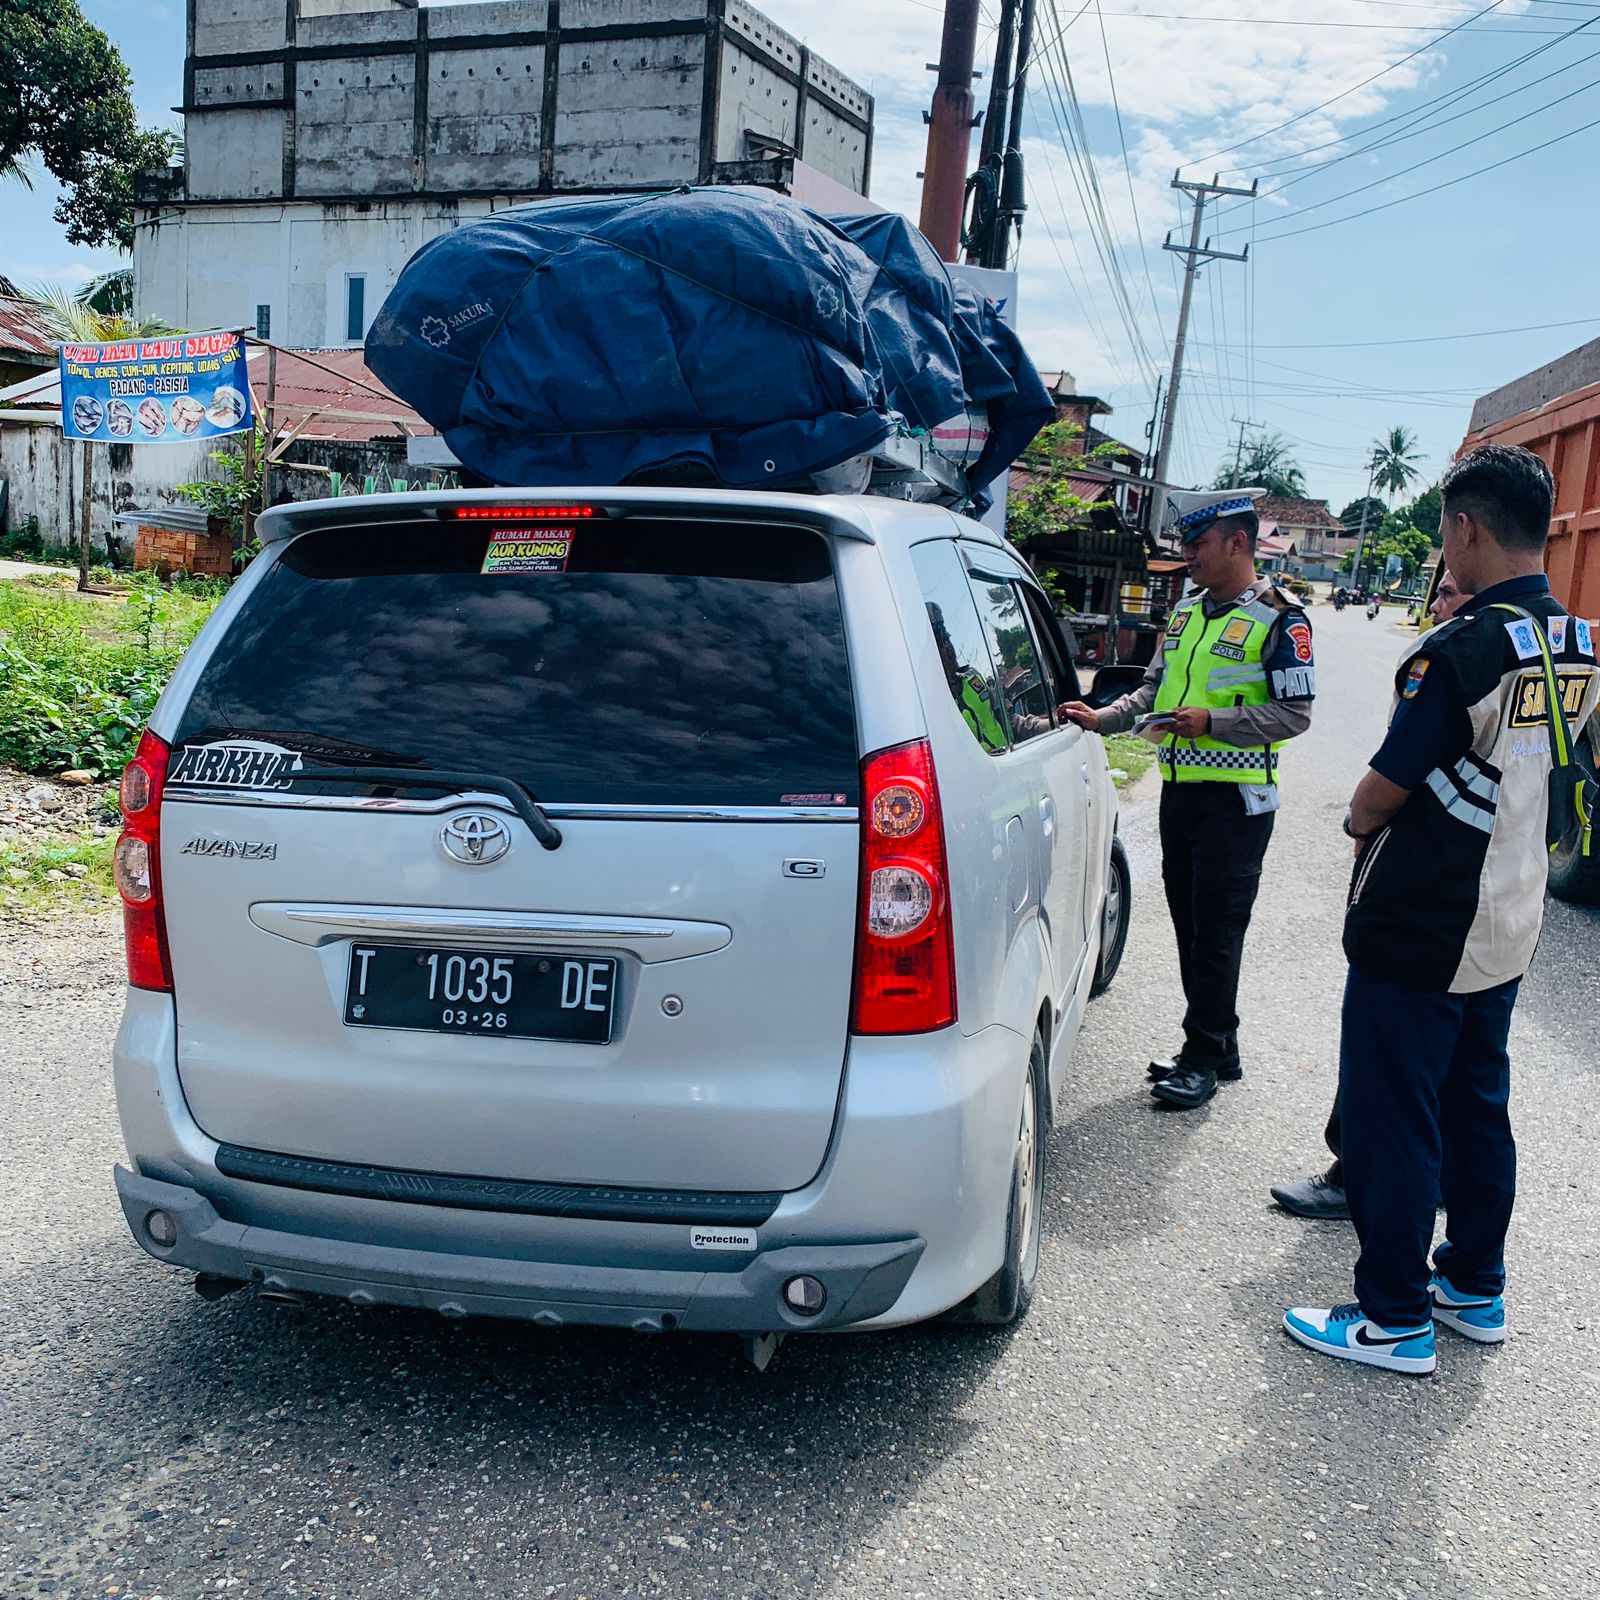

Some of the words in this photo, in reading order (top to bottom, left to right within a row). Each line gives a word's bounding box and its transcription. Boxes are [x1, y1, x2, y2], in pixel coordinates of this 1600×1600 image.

[447, 302, 494, 328] SAKURA
[141, 339, 183, 360] LAUT
[197, 359, 221, 373] UDANG
[110, 379, 146, 397] PADANG
[154, 376, 189, 395] PASISIA
[494, 531, 531, 540] RUMAH
[533, 529, 572, 539] MAKAN
[489, 542, 515, 558] AUR
[515, 542, 567, 558] KUNING
[1213, 644, 1244, 661] POLRI
[1520, 679, 1587, 717] SAAT
[168, 745, 303, 790] ARKHA
[180, 838, 278, 860] AVANZA
[789, 861, 818, 875] G
[356, 950, 376, 996] T
[427, 953, 515, 1004] 1035
[561, 961, 609, 1012] DE
[694, 1234, 749, 1244] Protection
